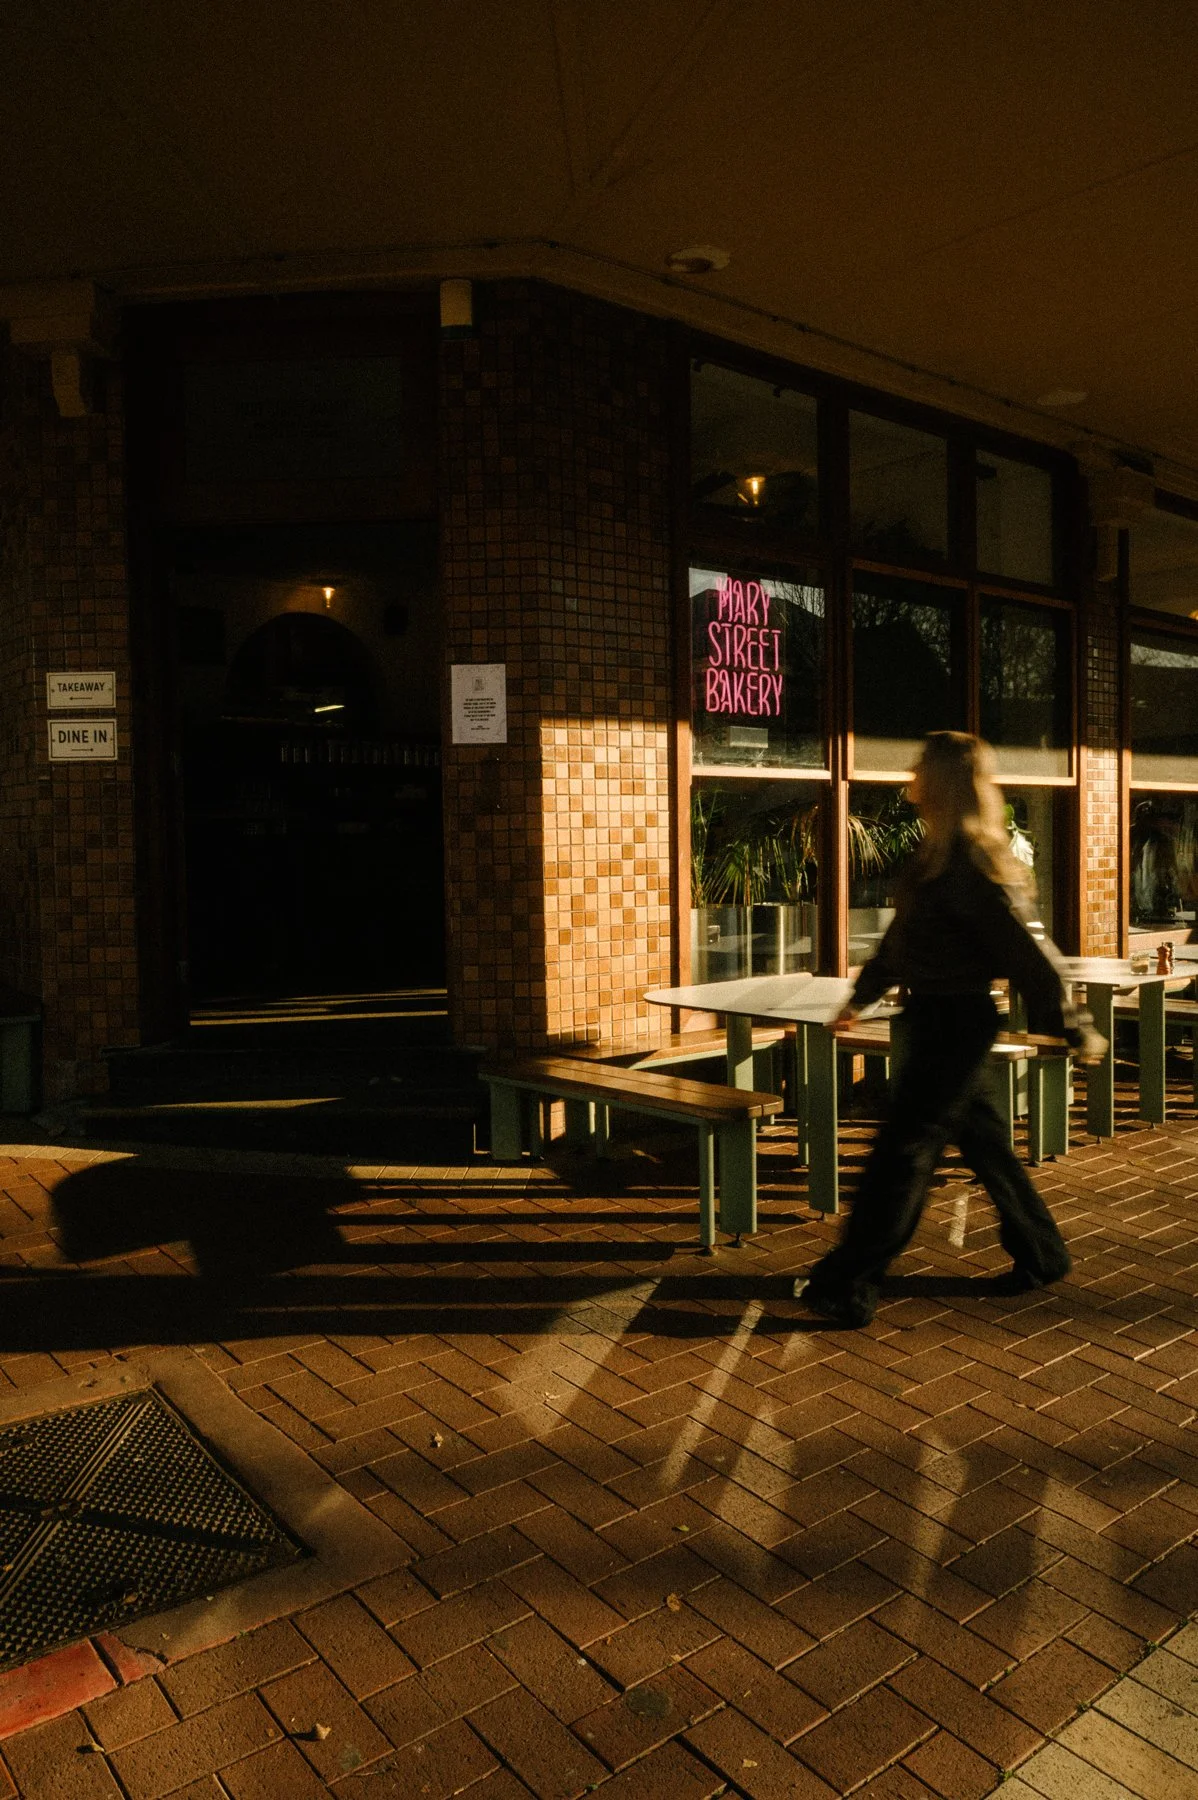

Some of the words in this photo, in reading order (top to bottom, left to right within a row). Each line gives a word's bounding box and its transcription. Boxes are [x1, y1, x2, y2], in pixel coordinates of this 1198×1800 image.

[715, 576, 770, 626] MARY
[707, 621, 781, 671] STREET
[57, 682, 105, 692] TAKEAWAY
[705, 667, 783, 716] BAKERY
[58, 730, 88, 743] DINE
[94, 730, 107, 743] IN
